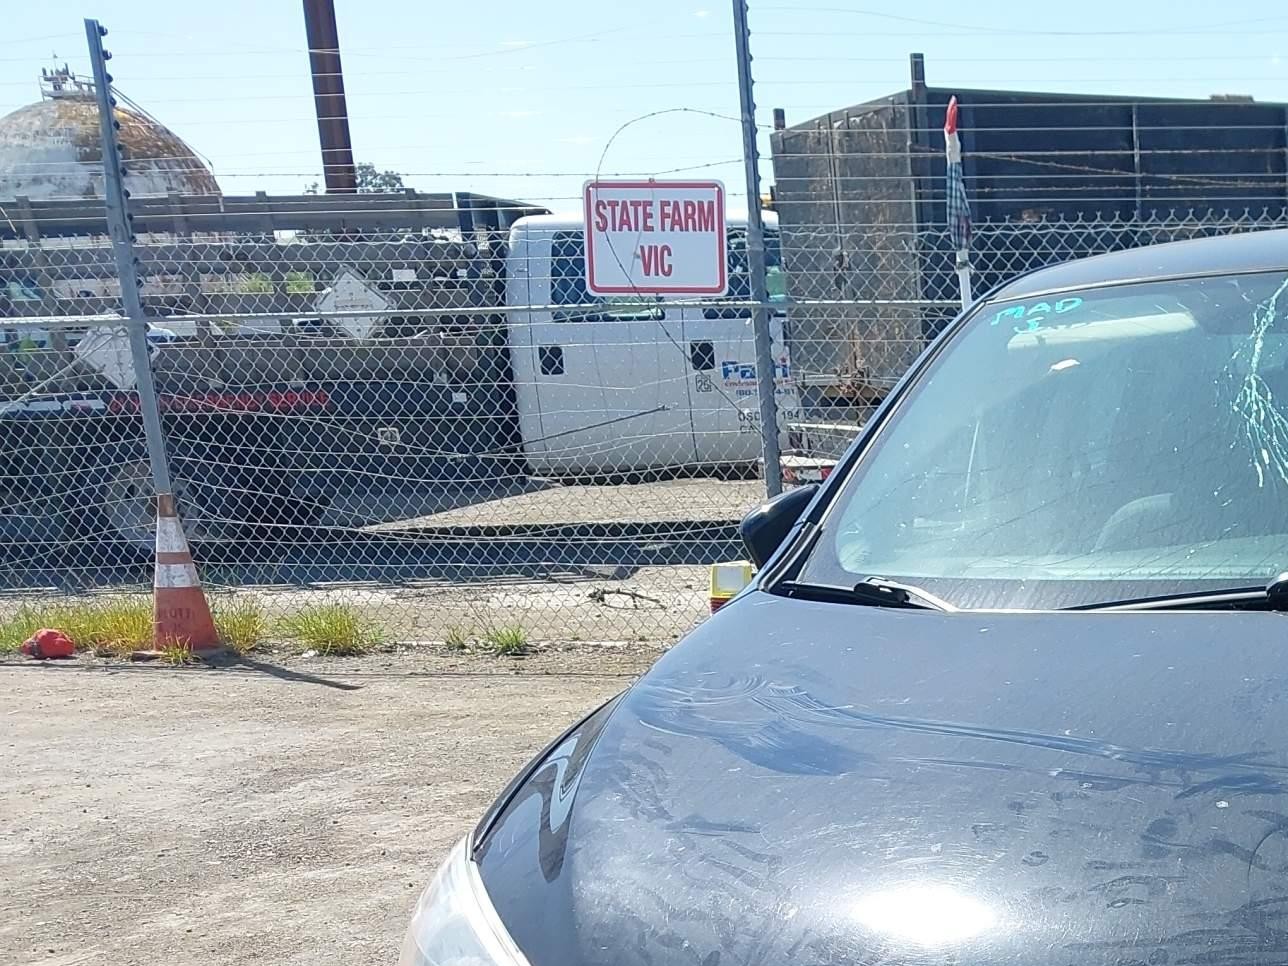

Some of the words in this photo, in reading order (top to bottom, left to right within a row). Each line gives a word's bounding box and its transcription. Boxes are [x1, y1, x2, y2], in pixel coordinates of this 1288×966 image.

[594, 199, 655, 233] STATE
[659, 200, 715, 232] FARM
[639, 244, 673, 278] VIC
